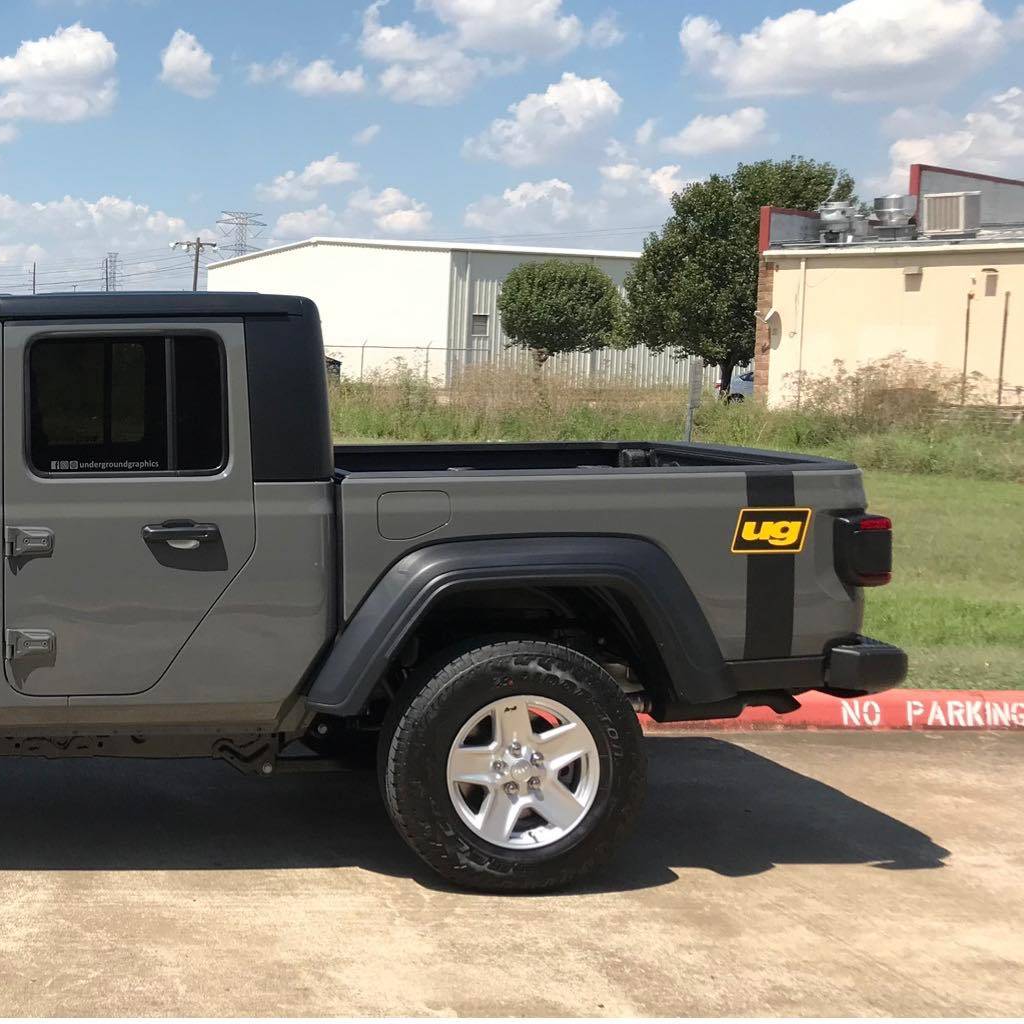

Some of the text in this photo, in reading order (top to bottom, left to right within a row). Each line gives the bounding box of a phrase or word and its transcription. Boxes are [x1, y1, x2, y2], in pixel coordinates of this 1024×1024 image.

[79, 460, 160, 470] undergroundgraphics
[741, 520, 803, 546] ug
[841, 700, 1024, 727] NO PARKING
